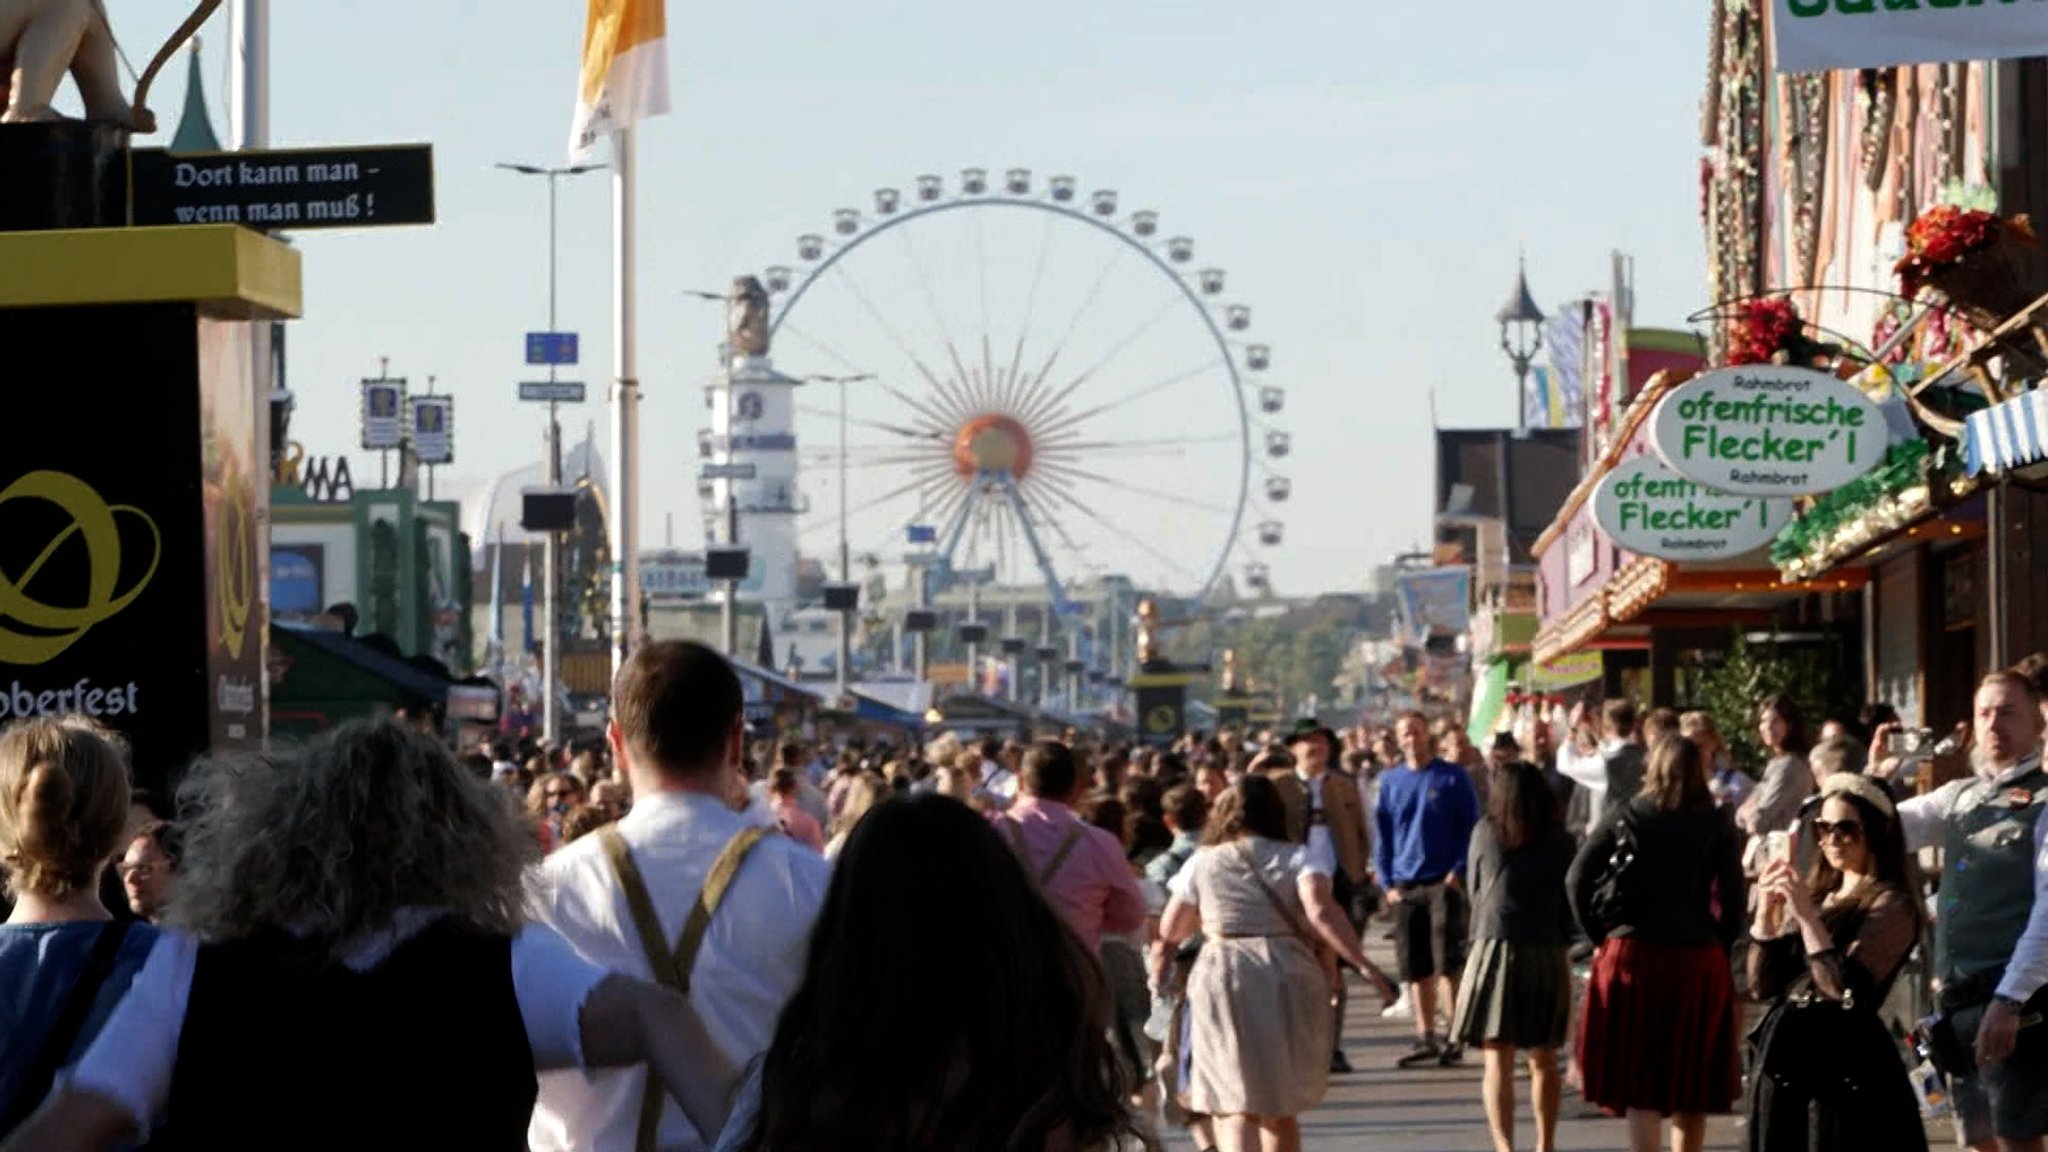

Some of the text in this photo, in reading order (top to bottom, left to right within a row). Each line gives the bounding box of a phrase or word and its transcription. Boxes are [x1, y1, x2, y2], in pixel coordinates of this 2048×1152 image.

[174, 162, 233, 187] Dort
[239, 161, 299, 185] kann
[306, 162, 359, 182] man
[174, 204, 240, 223] wenn
[248, 202, 300, 221] man
[1733, 375, 1811, 391] Rahmbrot
[1677, 390, 1866, 427] ofenfrische
[1729, 468, 1809, 486] Rahmbrot
